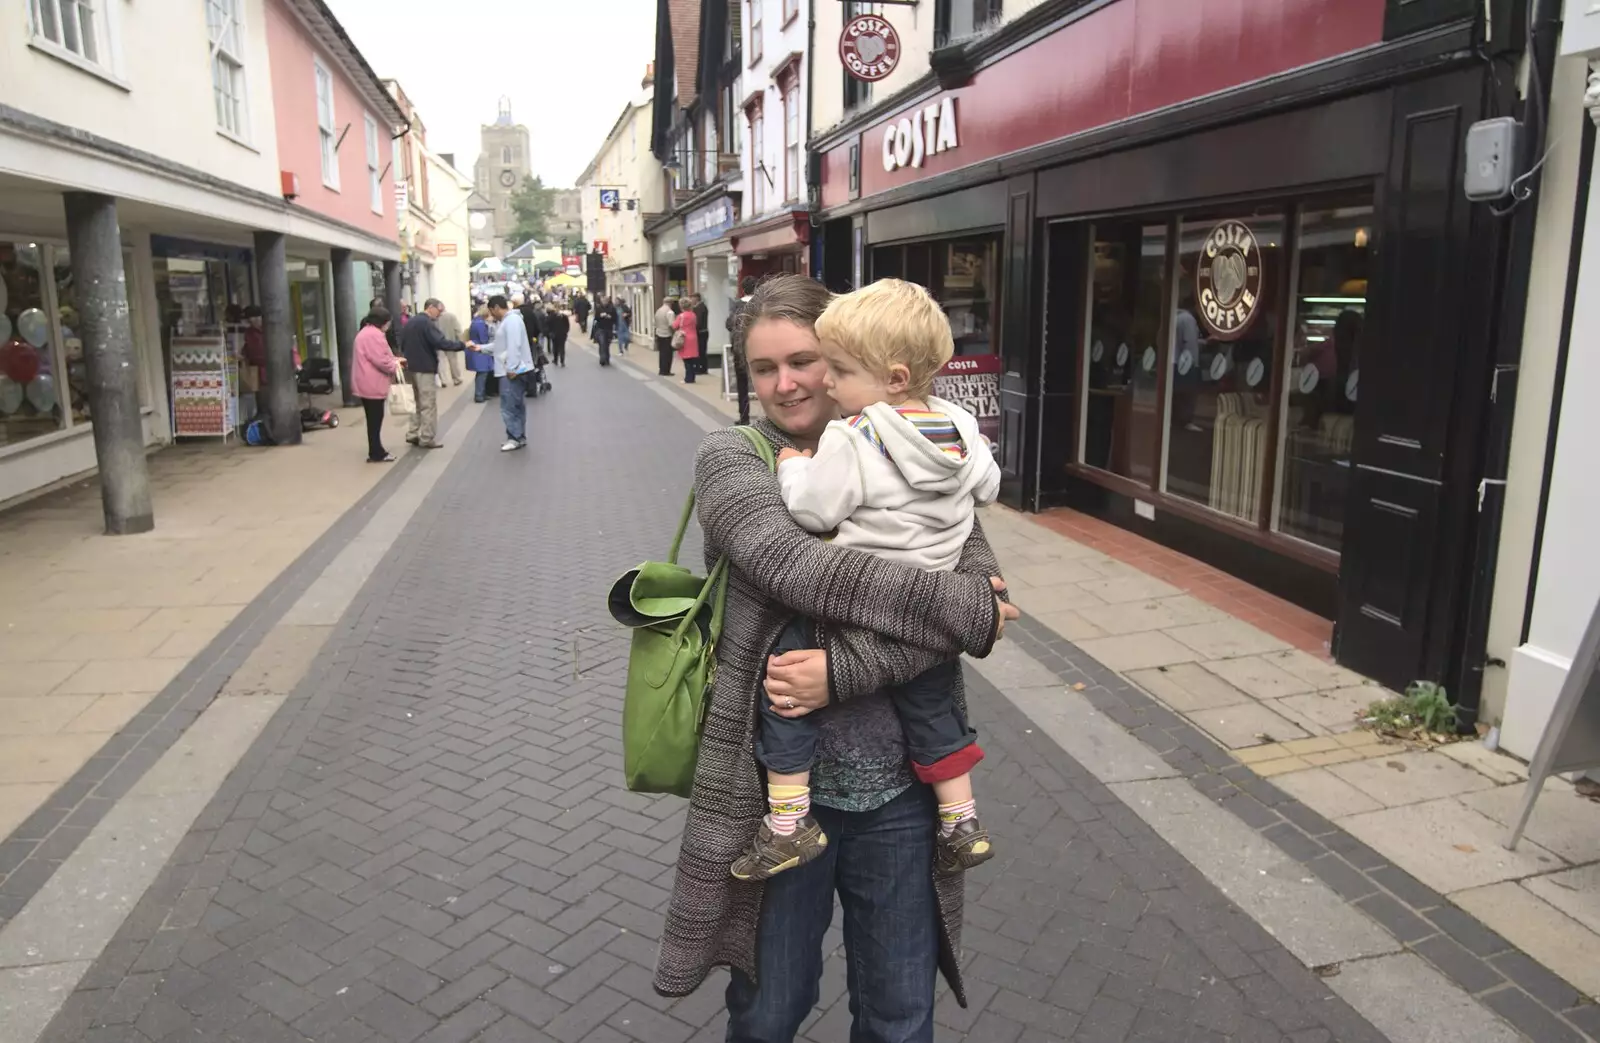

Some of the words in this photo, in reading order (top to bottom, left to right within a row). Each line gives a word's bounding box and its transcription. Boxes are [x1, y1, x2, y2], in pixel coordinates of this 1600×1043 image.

[849, 20, 890, 38] COSTA
[846, 53, 894, 76] COFFEE
[882, 97, 959, 172] COSTA
[1206, 224, 1253, 258] COSTA
[1201, 288, 1256, 329] COFFEE
[947, 360, 978, 370] COSTA
[935, 381, 1000, 400] PREFER
